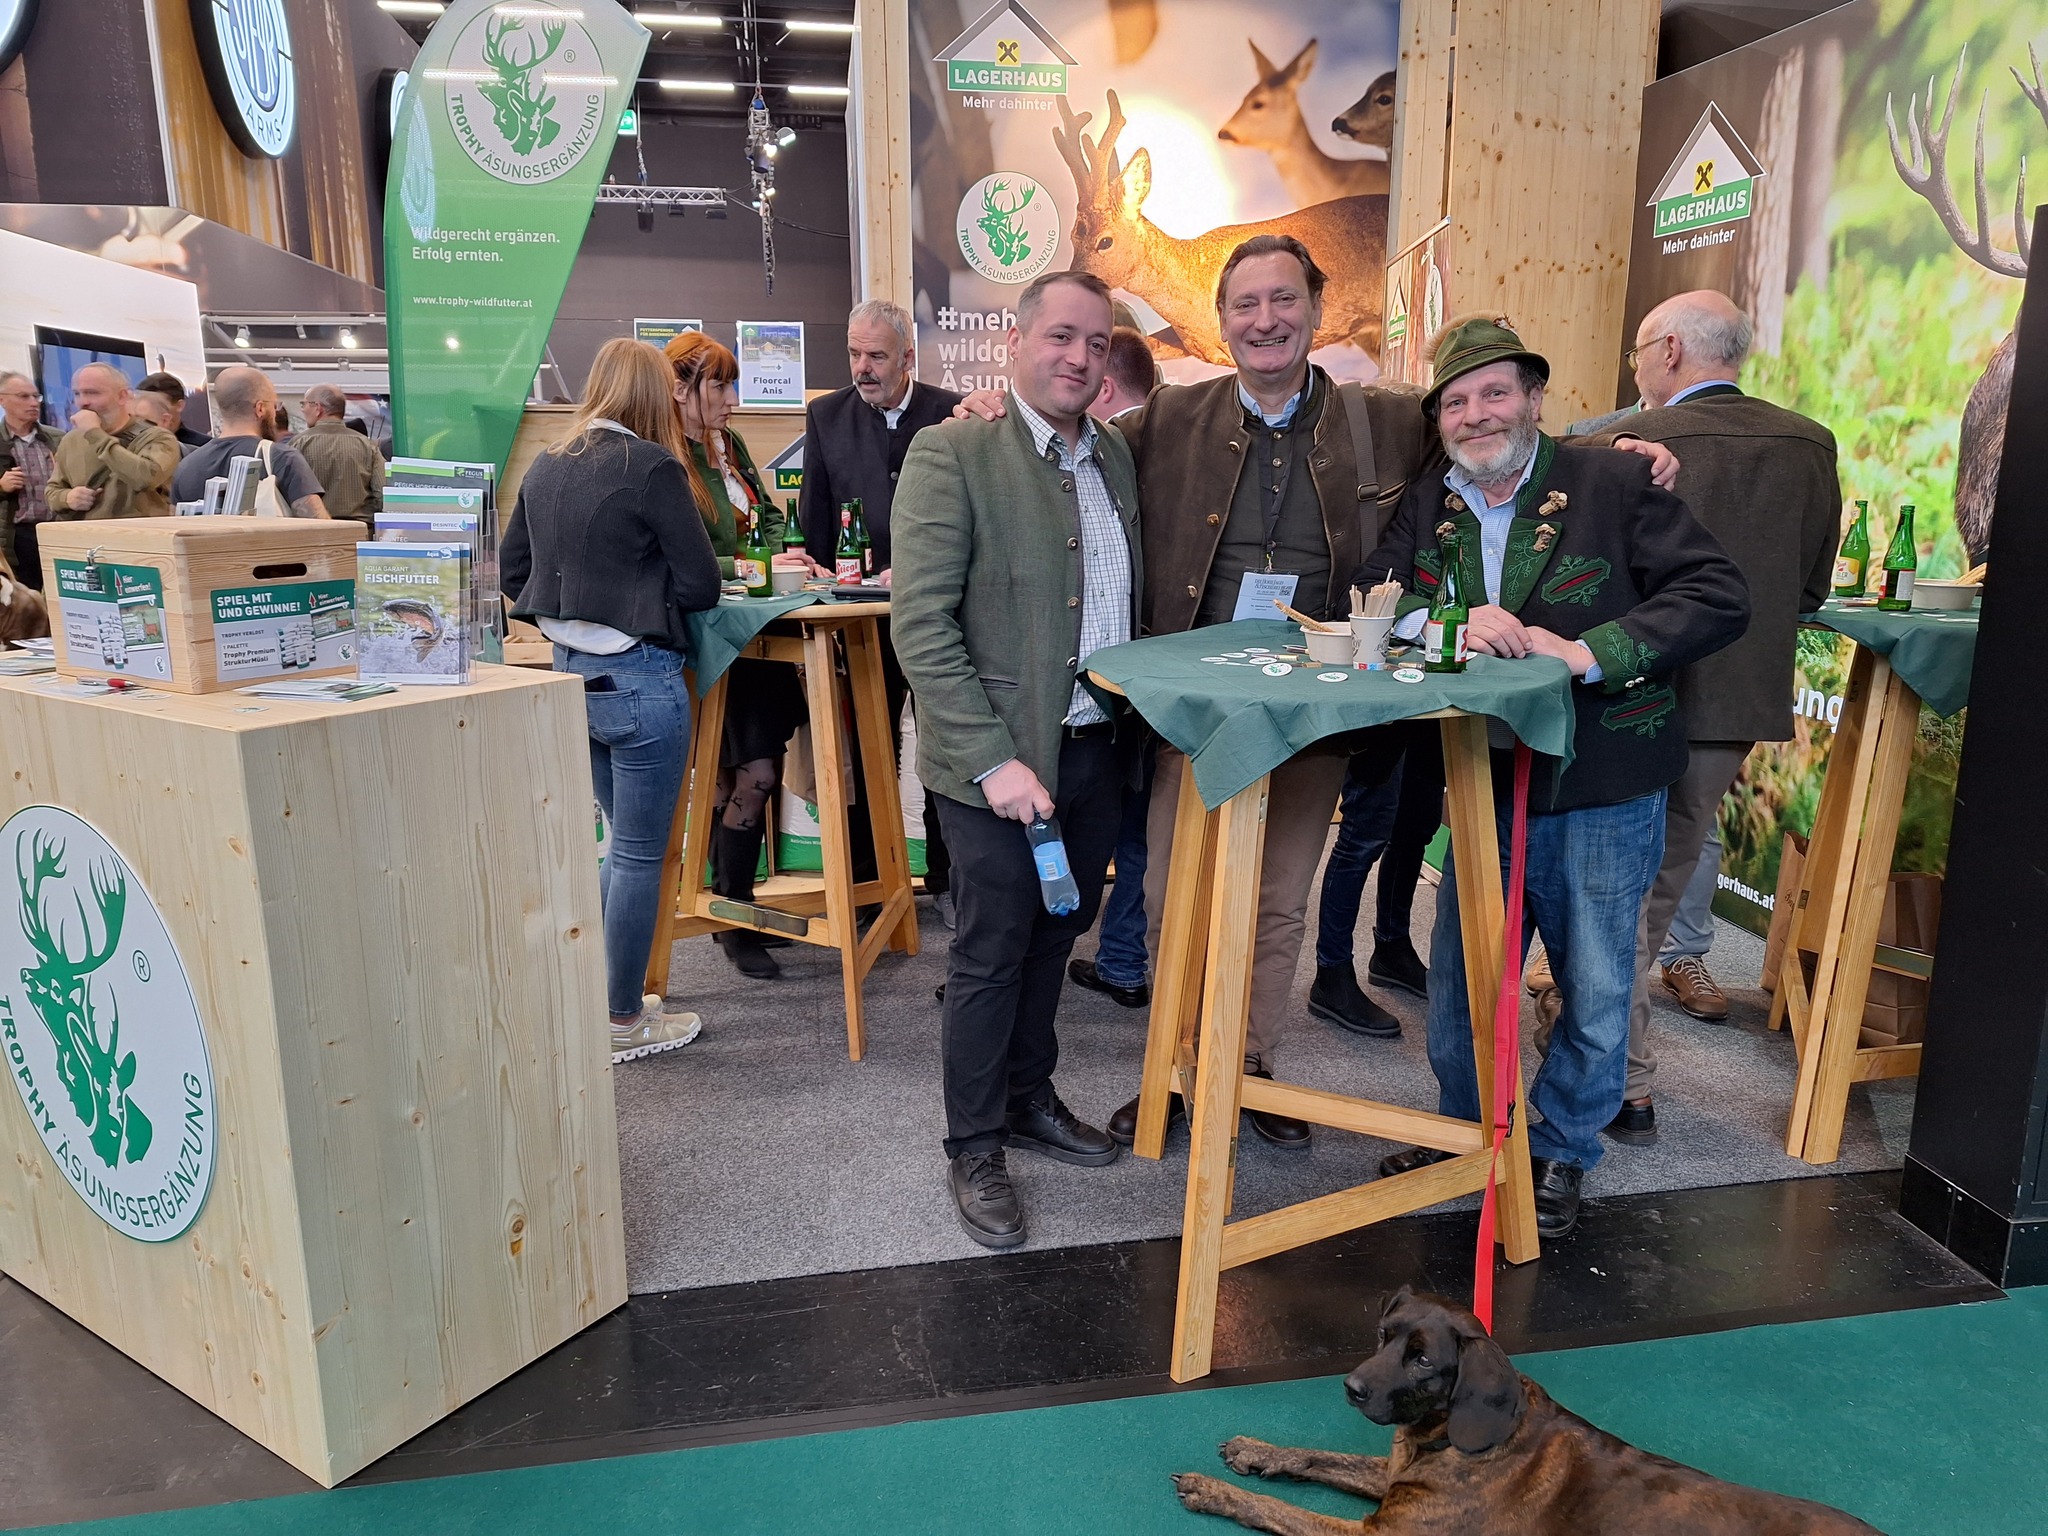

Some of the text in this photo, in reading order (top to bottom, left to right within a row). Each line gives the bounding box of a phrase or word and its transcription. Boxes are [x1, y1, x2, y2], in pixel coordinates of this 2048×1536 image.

[954, 68, 1063, 87] LAGERHAUS
[963, 95, 1053, 110] Mehr dahinter
[245, 102, 283, 145] ARMS
[451, 94, 600, 179] TROPHY ÄSUNGSERGÄNZUNG
[1659, 190, 1747, 227] LAGERHAUS
[411, 227, 560, 244] Wildgerecht ergänzen.
[1662, 229, 1736, 255] Mehr dahinter
[412, 247, 503, 263] Erfolg ernten.
[960, 227, 1057, 281] TROPHY ÄSUNGSERGÄNZUNG
[413, 296, 533, 308] www.trophy-wildfutter.at
[937, 338, 1013, 367] wildg
[753, 377, 791, 385] Floorcal
[939, 363, 1013, 393] Äsun
[60, 569, 78, 580] SPIEL
[836, 561, 858, 576] Stiegl
[62, 581, 74, 590] UND
[364, 574, 440, 584] FISCHFUTTER
[216, 593, 272, 607] SPIEL MIT
[218, 602, 301, 618] UND GEWINNE!
[223, 647, 276, 659] Trophy Premium
[224, 656, 269, 667] StrukturMüsli
[1717, 873, 1776, 911] gerhaus.at
[0, 995, 204, 1228] TROPHY ÄSUNGSERGÄNZUNG
